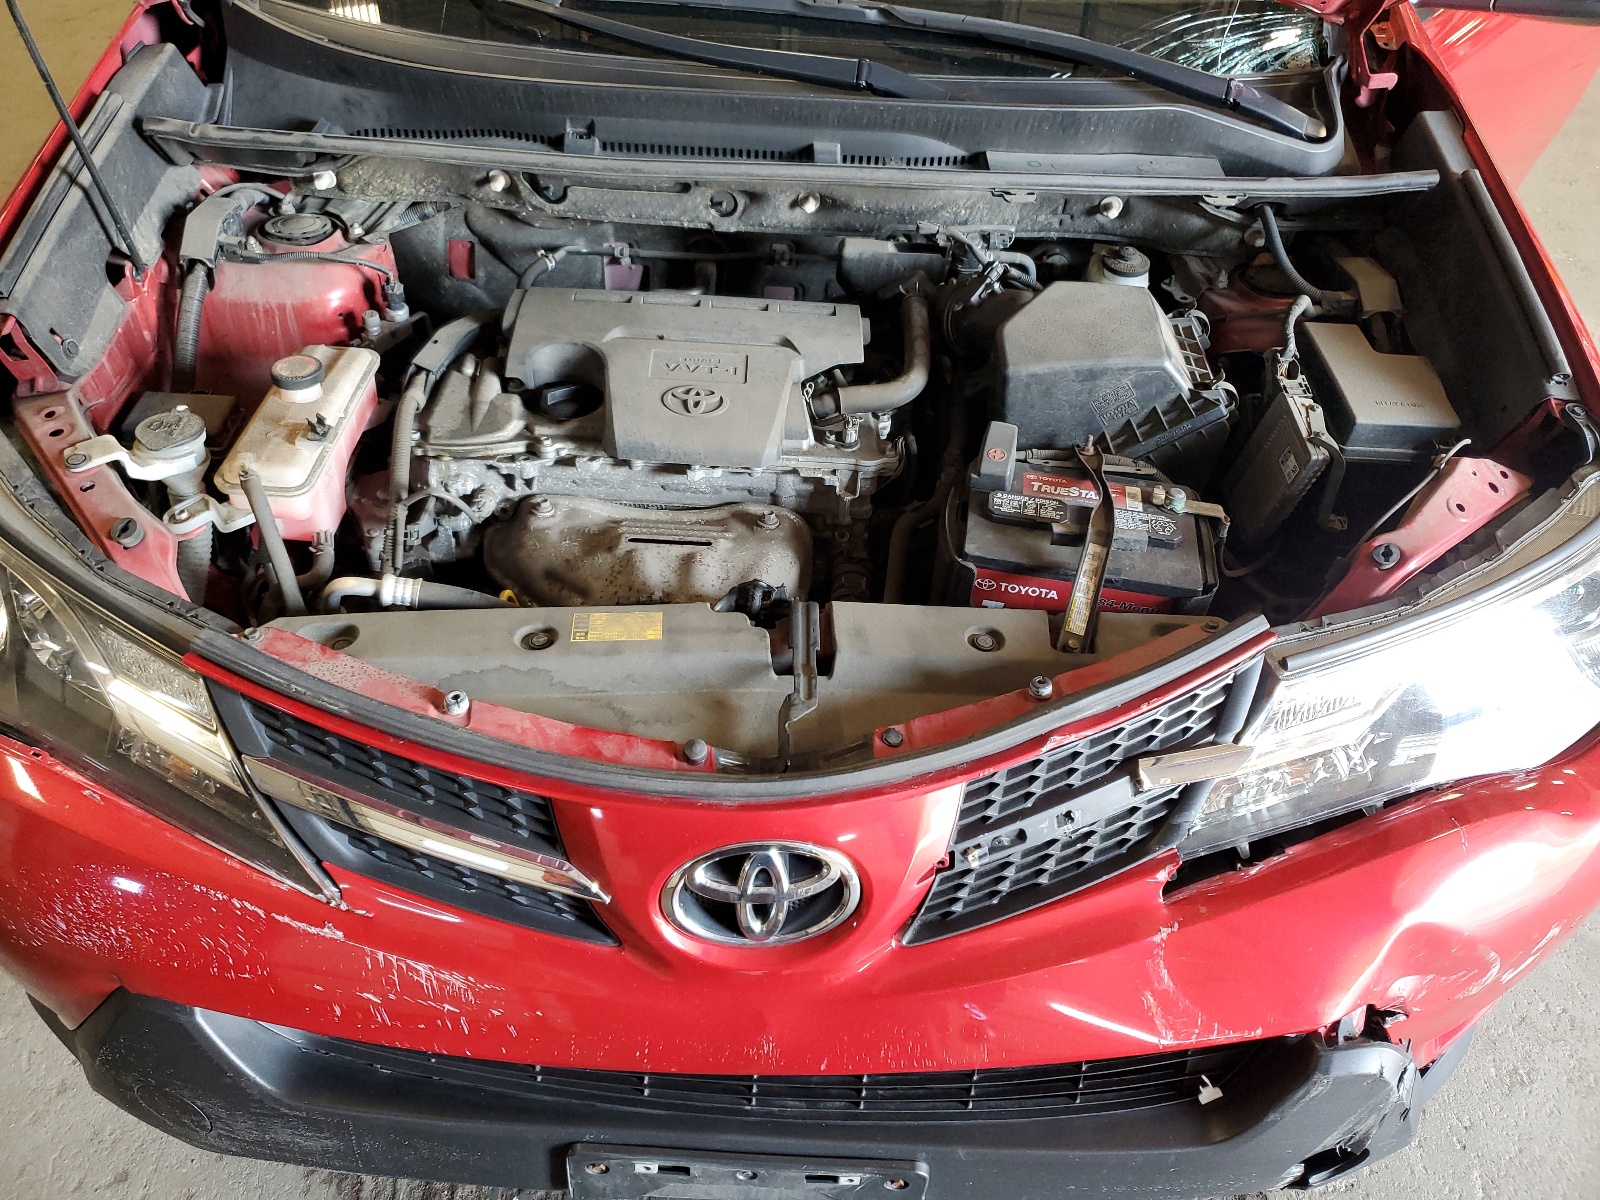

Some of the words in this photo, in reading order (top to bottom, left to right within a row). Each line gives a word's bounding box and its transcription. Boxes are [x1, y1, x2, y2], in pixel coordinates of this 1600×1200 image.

[1039, 475, 1068, 484] TOYOTA
[1031, 481, 1100, 500] TRUESTA
[999, 582, 1059, 600] TOYOTA
